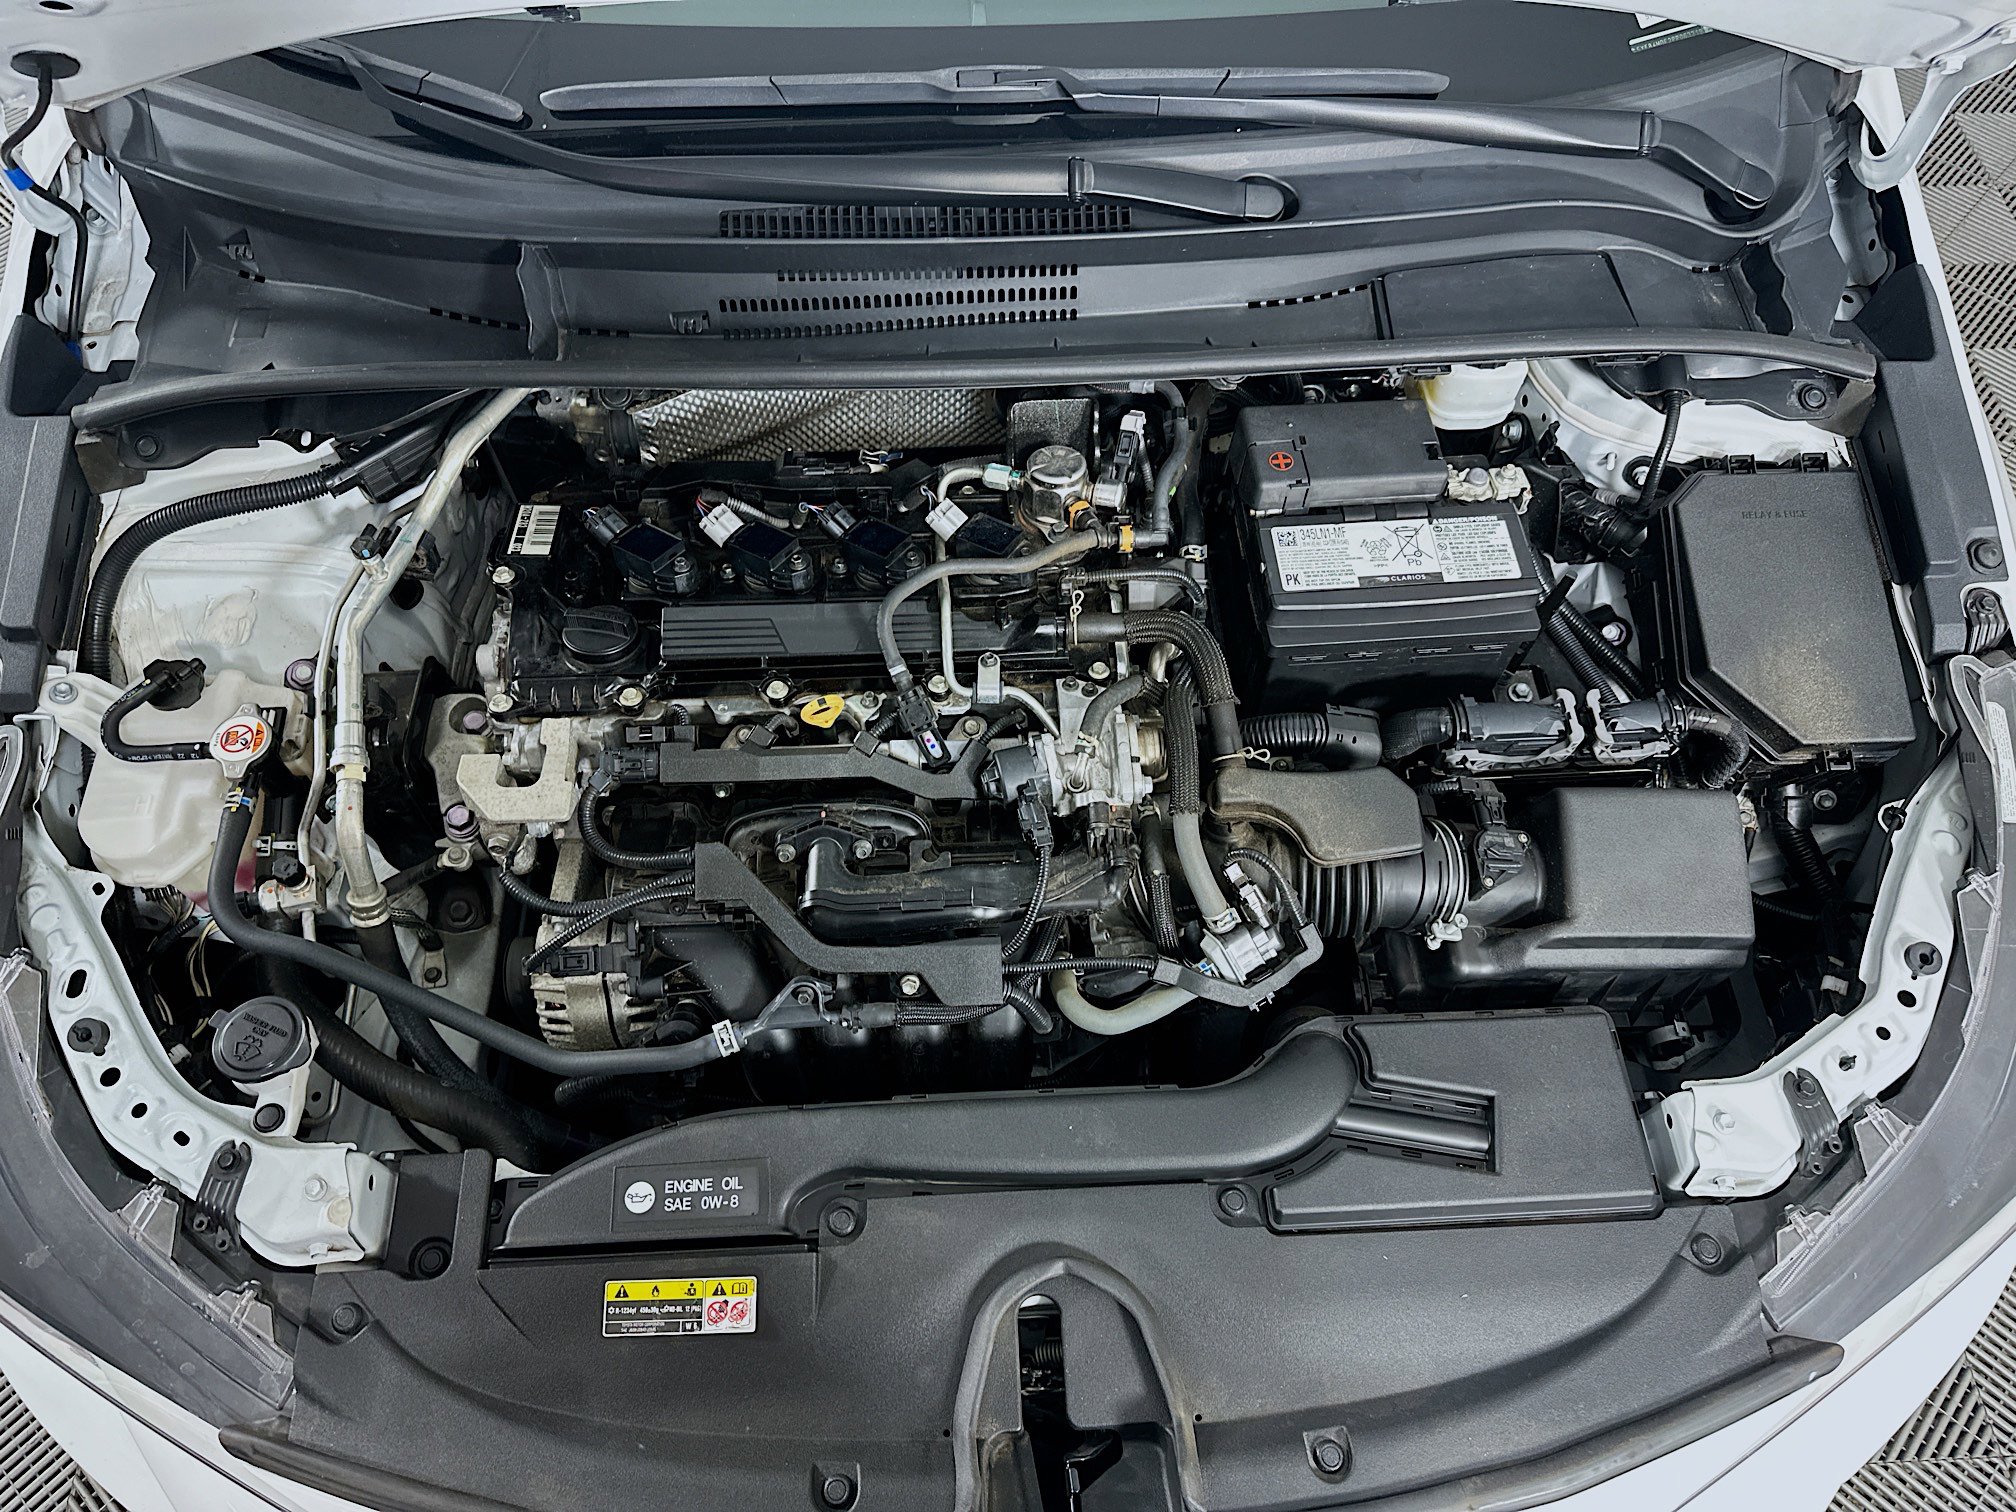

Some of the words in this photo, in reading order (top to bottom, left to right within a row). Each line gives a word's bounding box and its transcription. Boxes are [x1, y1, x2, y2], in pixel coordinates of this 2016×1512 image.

[1741, 511, 1772, 519] RELAY
[1784, 510, 1808, 518] FUSE
[1299, 526, 1347, 541] 345LN1-MF
[1407, 558, 1423, 567] Pb
[1285, 573, 1301, 586] PK
[1390, 574, 1427, 582] CLARIOS
[664, 1178, 713, 1194] ENGINE
[721, 1176, 744, 1190] OIL
[664, 1197, 692, 1212] SAE
[701, 1195, 739, 1210] 0W-8
